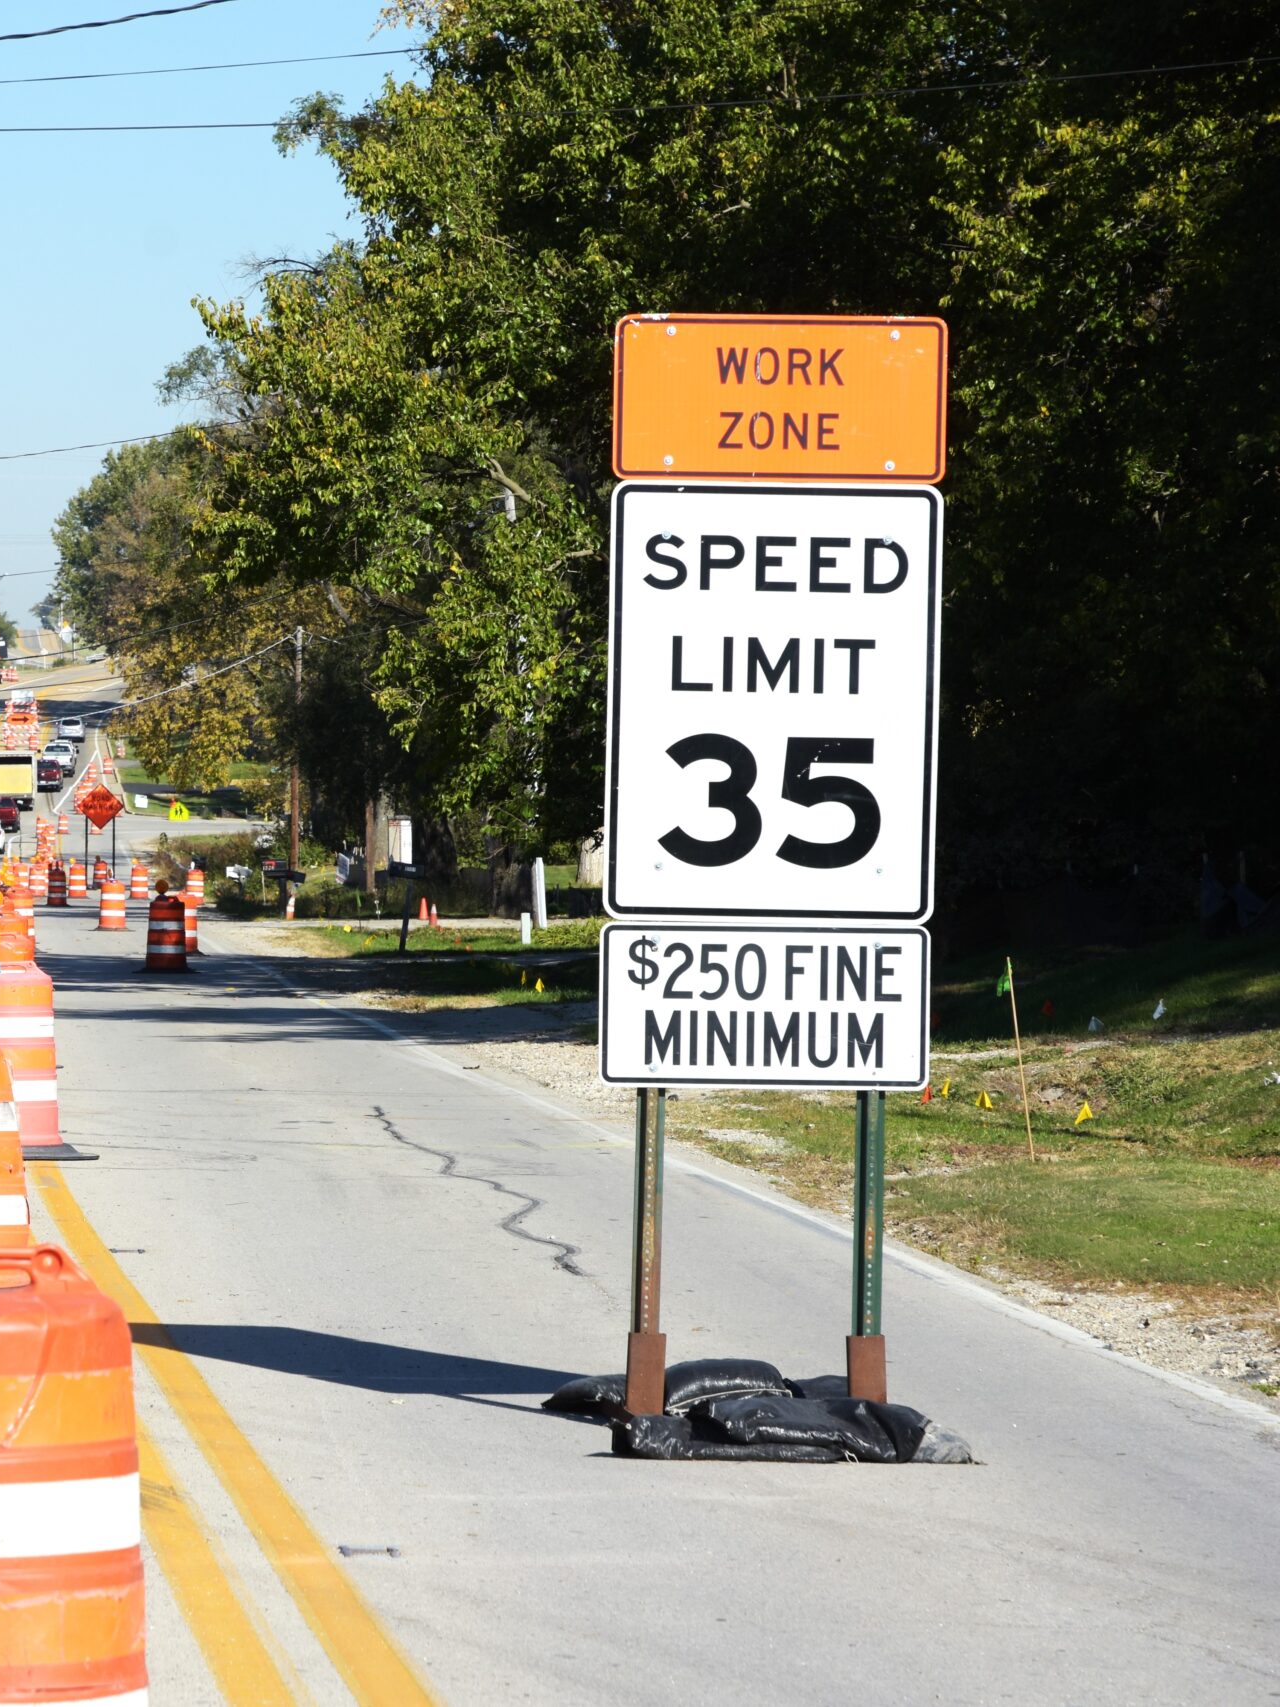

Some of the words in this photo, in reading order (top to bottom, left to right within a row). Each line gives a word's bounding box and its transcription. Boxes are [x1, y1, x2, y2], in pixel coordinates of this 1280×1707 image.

[716, 347, 845, 386] WORK
[718, 411, 840, 450] ZONE
[643, 535, 909, 594] SPEED
[672, 636, 876, 695] LIMIT
[658, 733, 881, 869] 35
[627, 935, 767, 1001] $250
[785, 945, 902, 1002] FINE
[644, 1009, 884, 1068] MINIMUM
